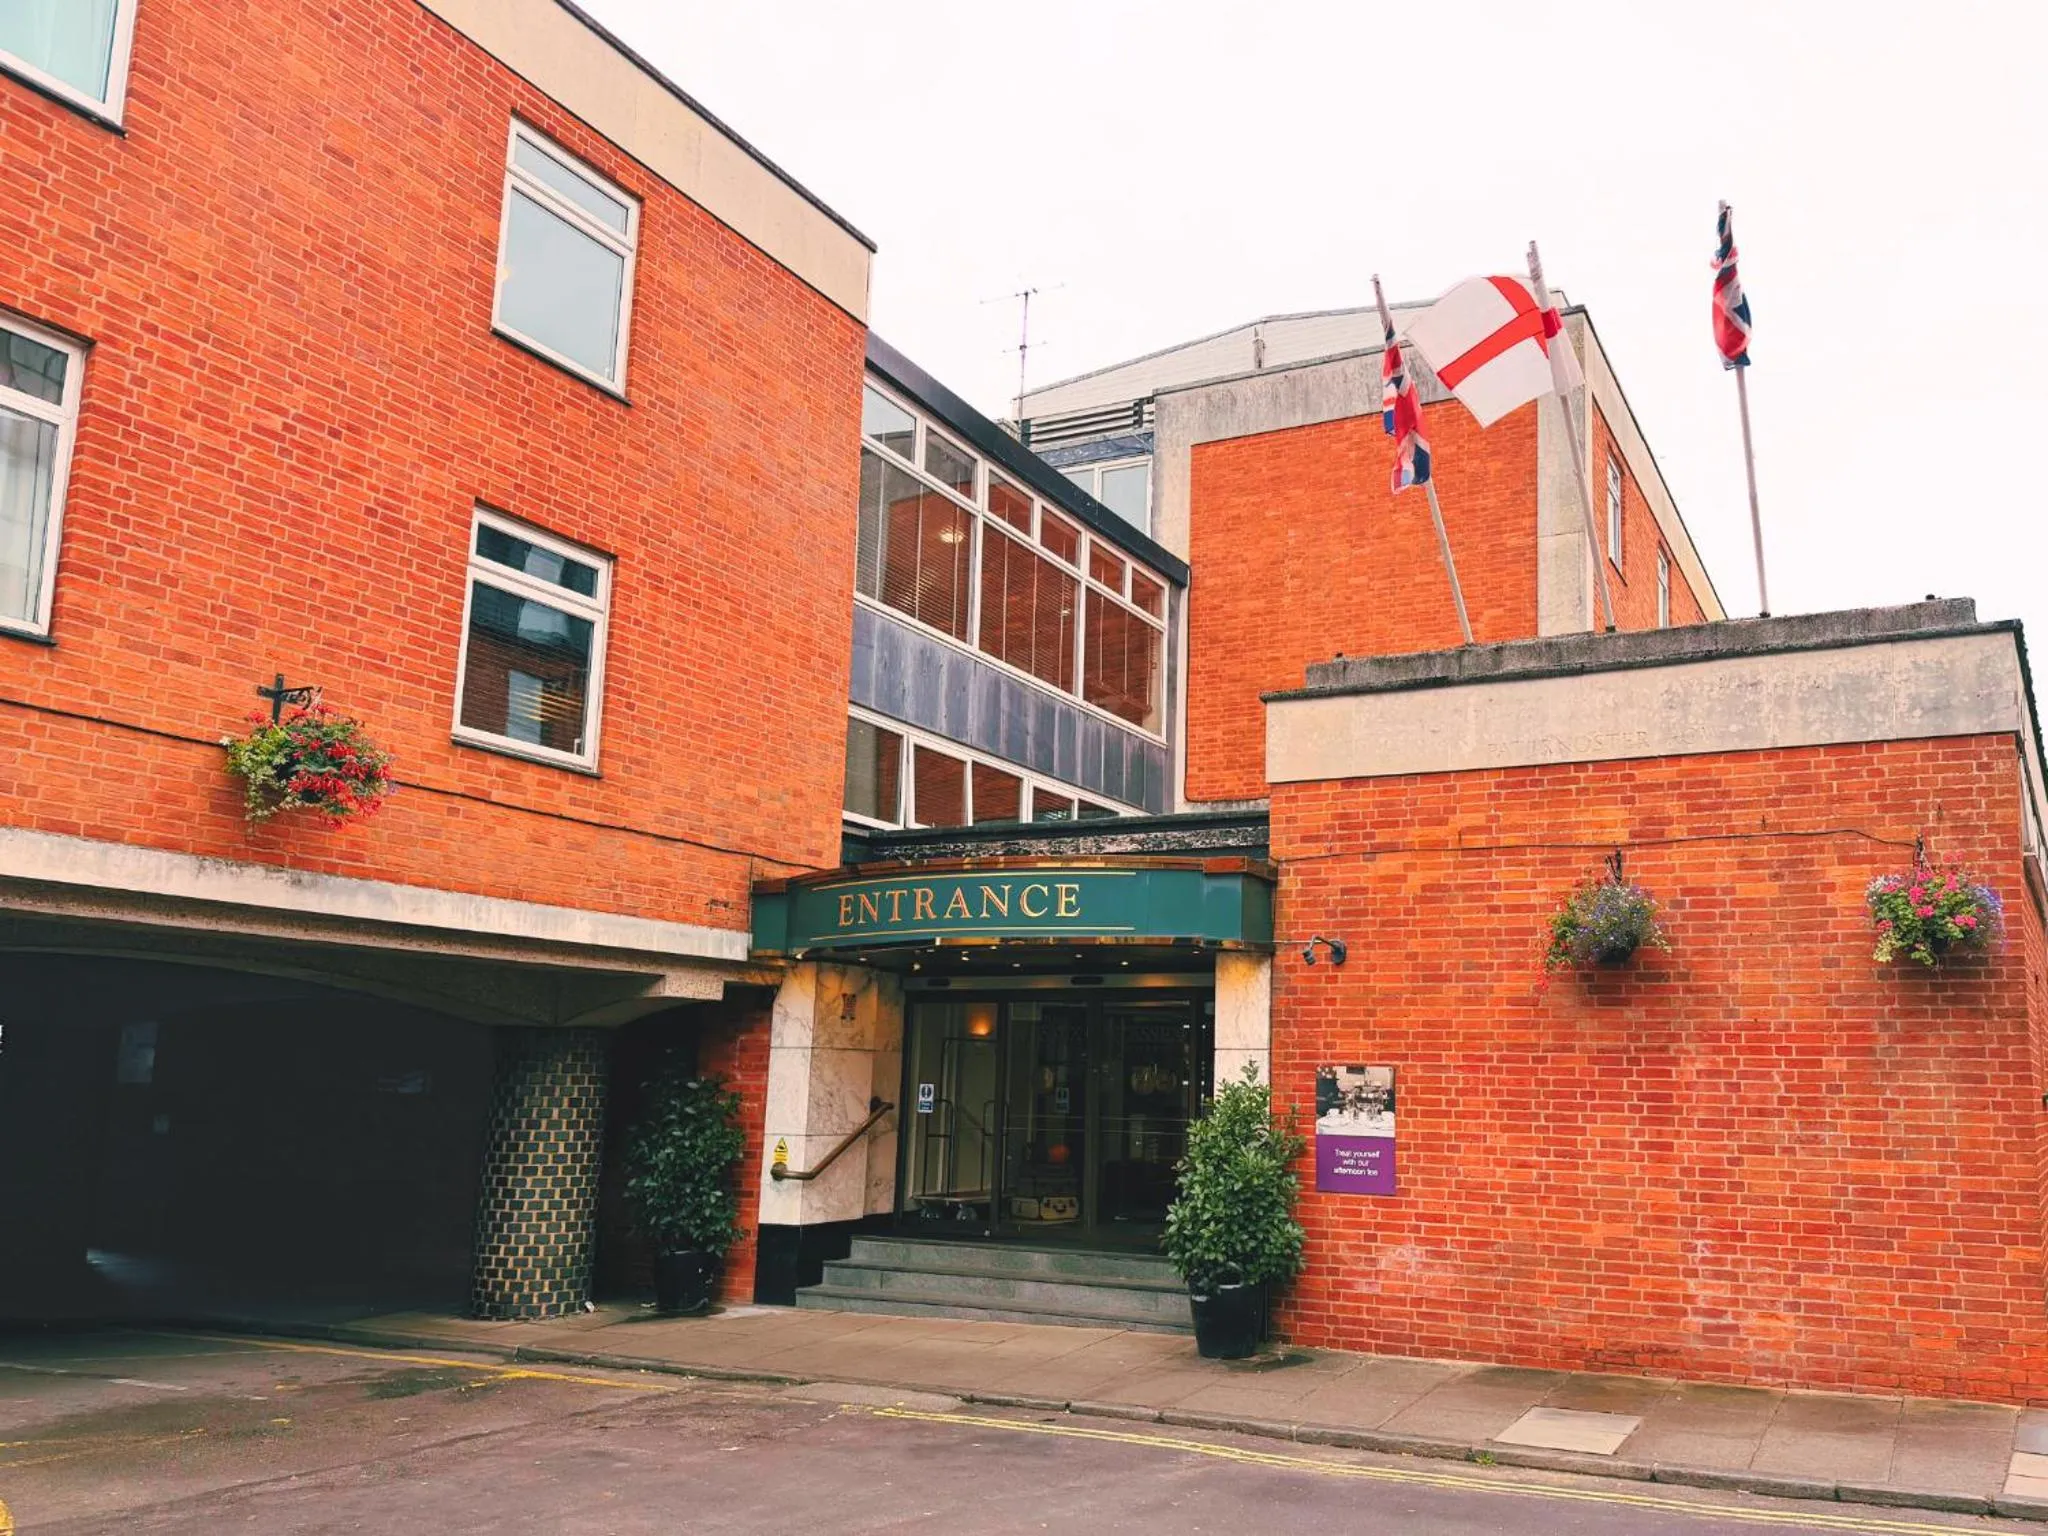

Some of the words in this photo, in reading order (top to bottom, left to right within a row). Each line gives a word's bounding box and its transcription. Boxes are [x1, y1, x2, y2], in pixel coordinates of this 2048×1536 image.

[837, 883, 1081, 927] ENTRANCE
[1334, 1148, 1351, 1157] Treat
[1353, 1150, 1380, 1159] yourself
[1343, 1158, 1356, 1166] with
[1333, 1167, 1365, 1175] afternoon
[1367, 1168, 1378, 1176] tea
